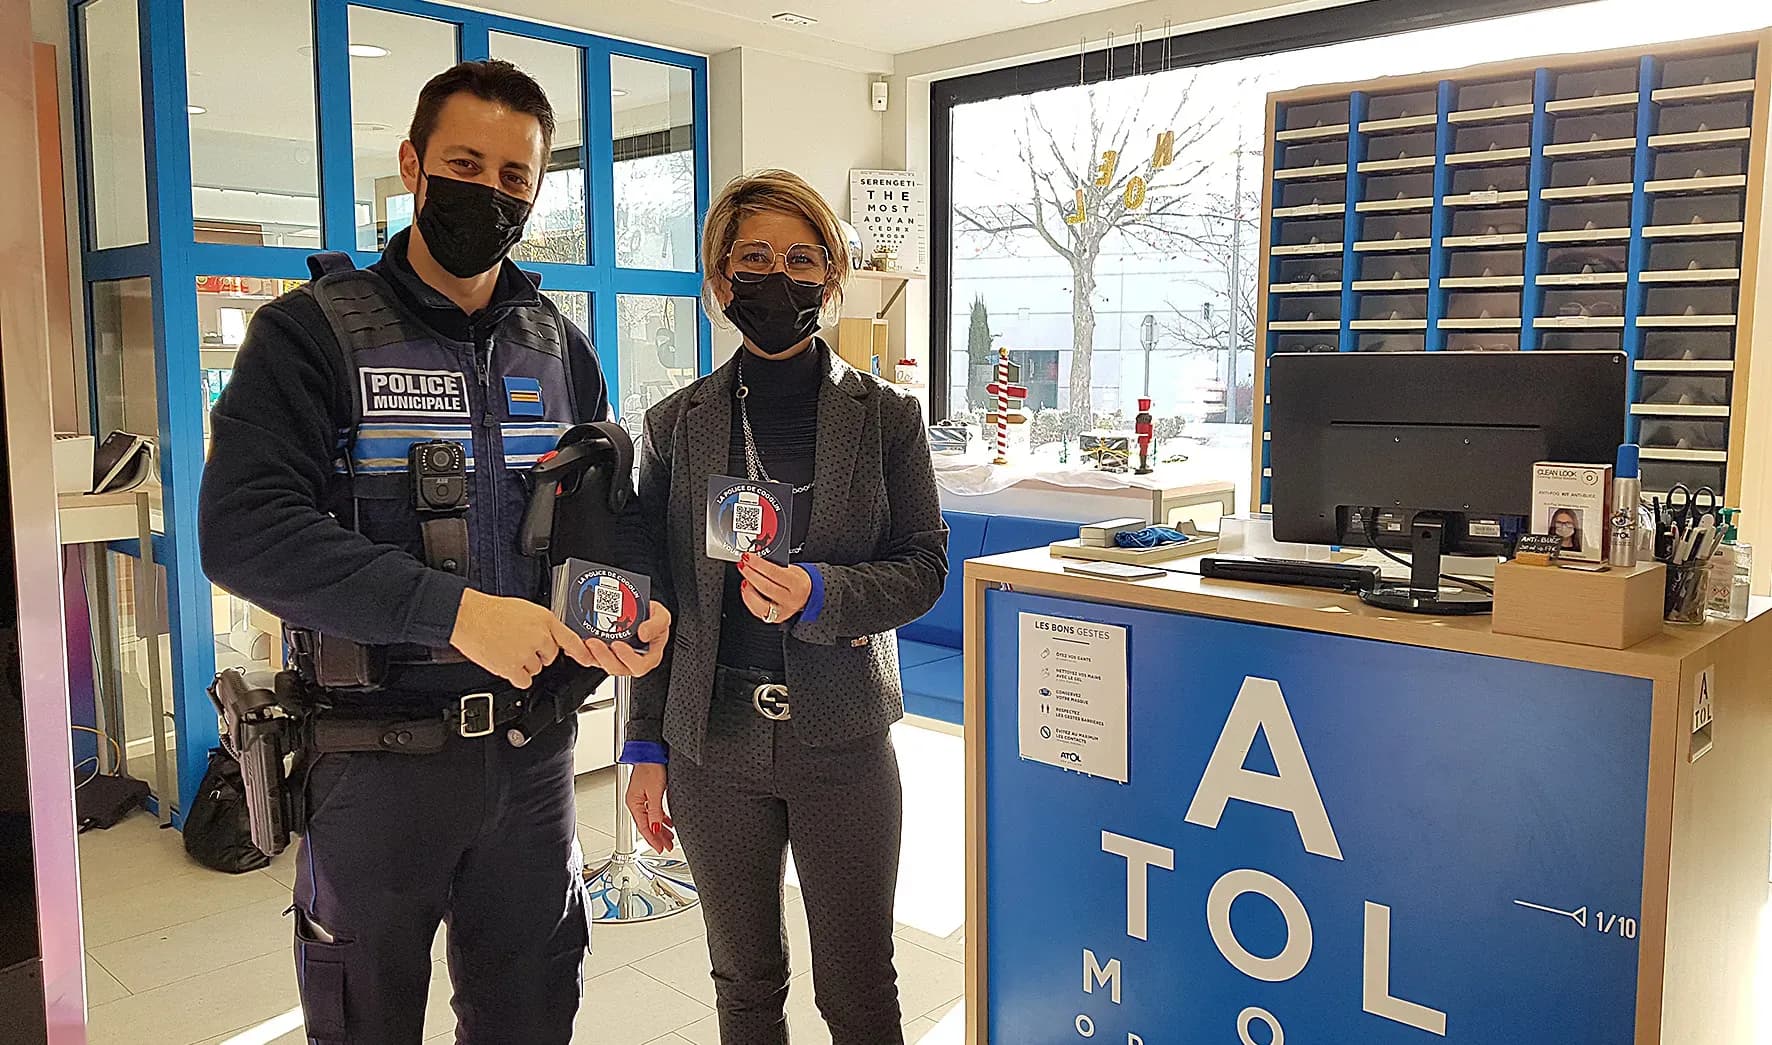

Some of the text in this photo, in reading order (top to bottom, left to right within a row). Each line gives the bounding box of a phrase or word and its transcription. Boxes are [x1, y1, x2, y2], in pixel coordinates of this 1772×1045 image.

[860, 178, 915, 187] SERENGETI
[867, 190, 910, 201] THE
[868, 204, 909, 213] MOST
[864, 216, 914, 224] ADVAN
[371, 374, 460, 395] POLICE
[373, 395, 461, 410] MUNICIPALE
[1537, 468, 1558, 476] CLEAN
[724, 485, 745, 497] POLICE
[585, 570, 607, 580] POLICE
[607, 571, 617, 579] DE
[582, 620, 600, 636] VOUS
[1035, 620, 1110, 640] LES BONS GESTES
[1064, 735, 1087, 744] CONTACTS
[1060, 751, 1082, 762] ATOL
[1595, 911, 1637, 939] 1/10
